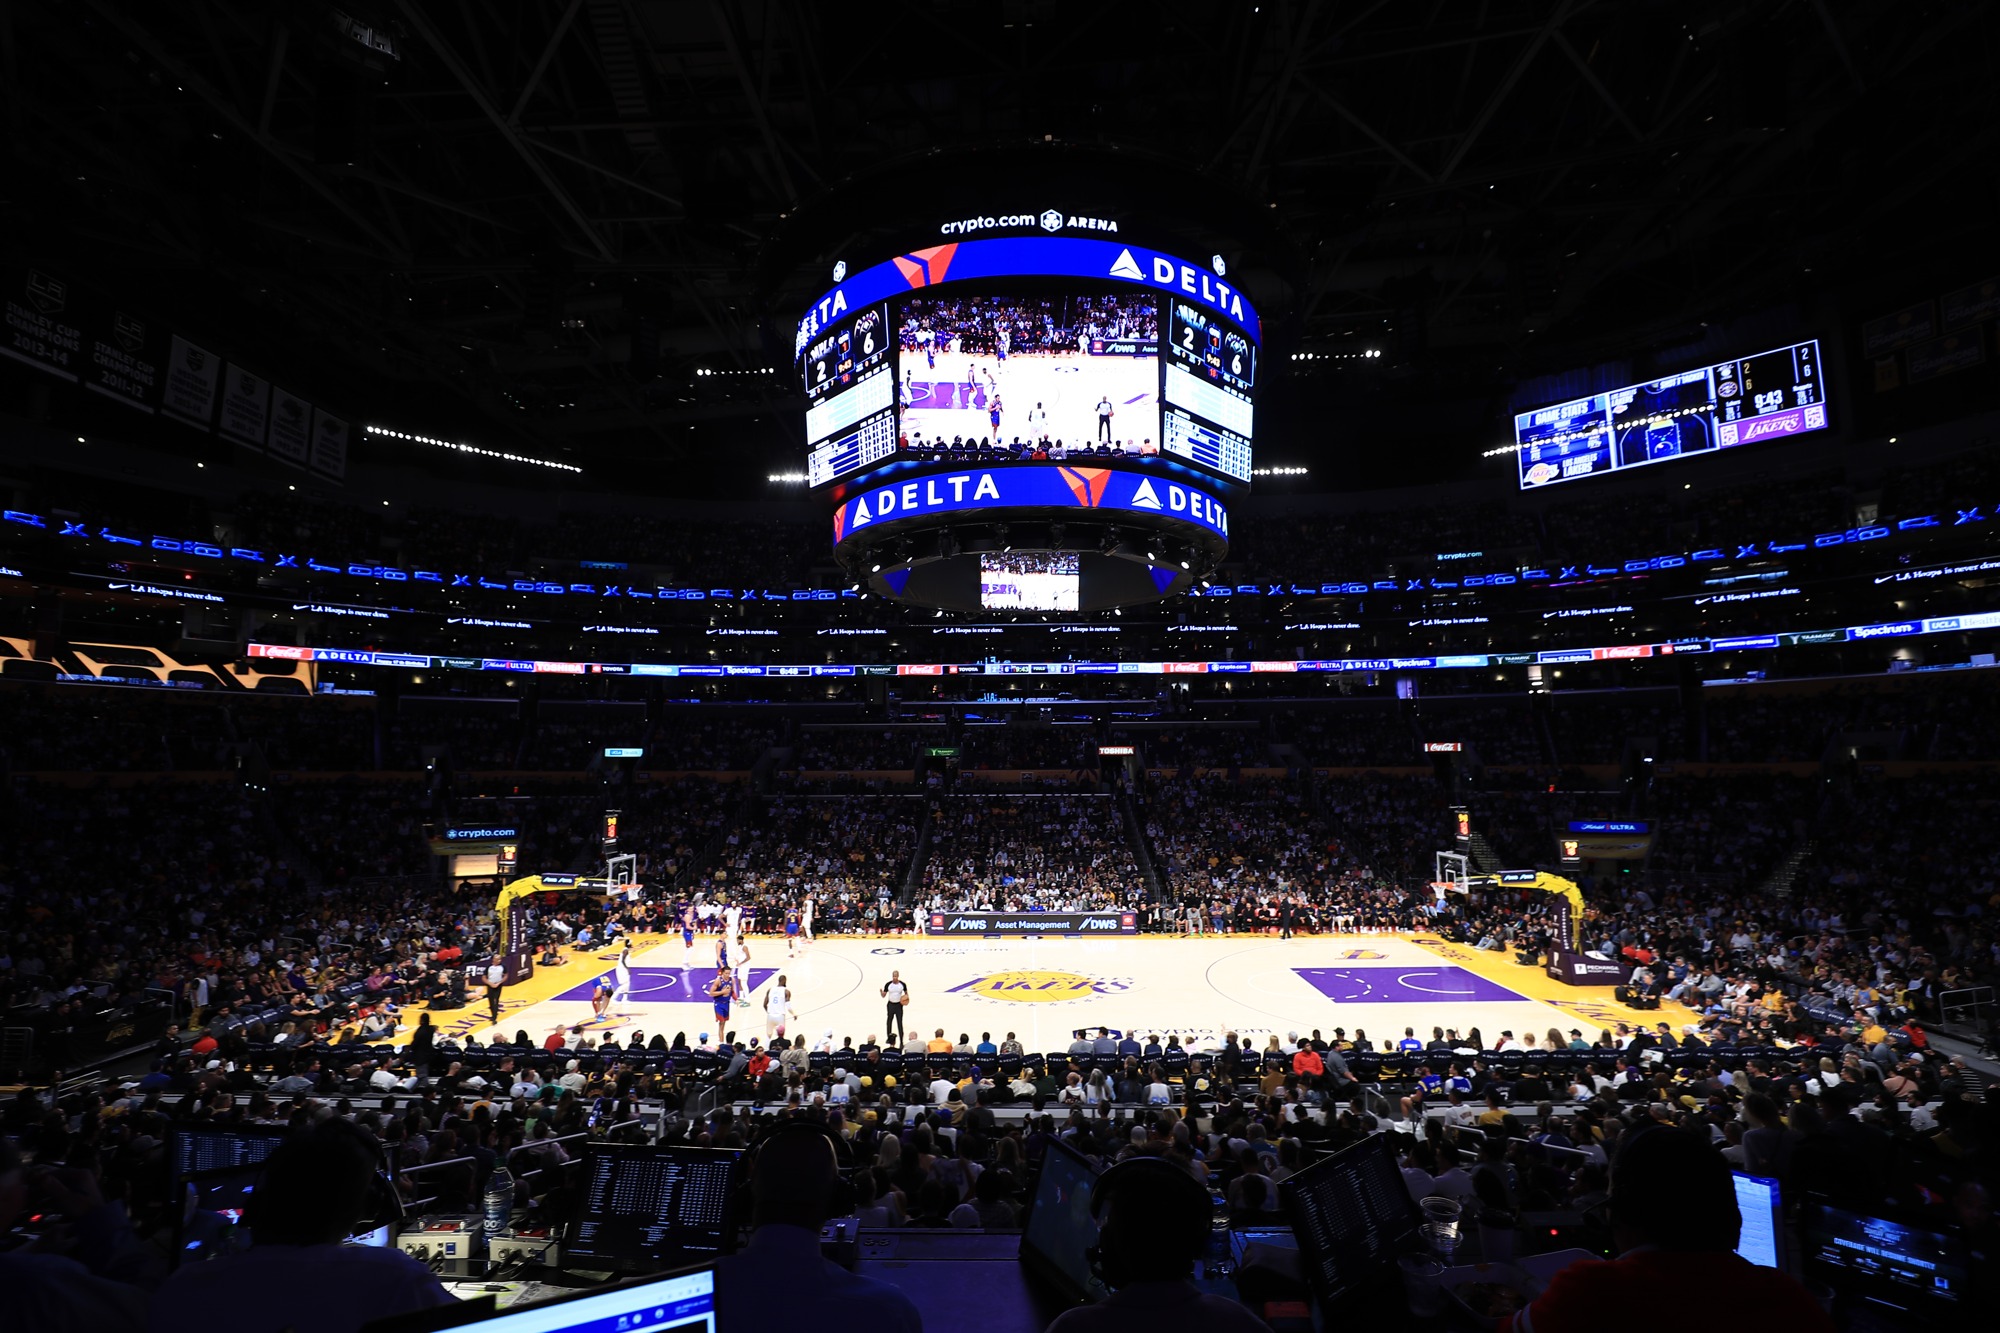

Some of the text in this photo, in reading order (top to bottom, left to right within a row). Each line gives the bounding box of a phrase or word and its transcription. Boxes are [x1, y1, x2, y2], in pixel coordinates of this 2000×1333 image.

[941, 215, 1118, 234] crypto.com ARENA
[1154, 256, 1244, 322] DELTA
[5, 312, 80, 352] CHAMPIONS
[56, 323, 80, 338] CUP
[863, 332, 875, 354] 6
[1183, 327, 1194, 350] 2
[13, 333, 70, 366] 2013-14
[1801, 347, 1809, 360] 2
[93, 352, 154, 387] CHAMPIONS
[136, 361, 155, 374] CUP
[1232, 354, 1242, 374] 6
[1743, 363, 1751, 374] 2
[1803, 364, 1811, 377] 6
[817, 361, 827, 383] 2
[101, 370, 144, 399] 2011-12
[1745, 379, 1752, 390] 6
[1754, 389, 1783, 409] 9:43
[1535, 401, 1588, 425] GAME STATS
[1742, 416, 1803, 441] LAKERS
[1573, 452, 1598, 465] ANGELES
[1563, 461, 1593, 477] LAKERS
[877, 473, 1000, 516] DELTA
[1169, 484, 1228, 537] DELTA
[1444, 551, 1483, 560] crypto.com
[1895, 572, 1912, 581] LA
[1954, 564, 1979, 573] never
[131, 584, 146, 592] LA
[1712, 595, 1726, 603] LA
[1855, 623, 1912, 638] Spectrum
[1931, 620, 1957, 630] UCLA
[330, 652, 369, 661] DELTA
[1393, 659, 1430, 669] Spectrum
[537, 663, 582, 672] TOSHIBA
[727, 666, 761, 675] Spectrum
[1253, 662, 1295, 671] TOSHIBA
[1355, 661, 1385, 669] DELTA
[458, 828, 515, 838] crypto.com
[960, 919, 1117, 930] DWS Asset Management DWS
[944, 976, 1135, 994] LAKERS
[773, 996, 779, 1004] 6
